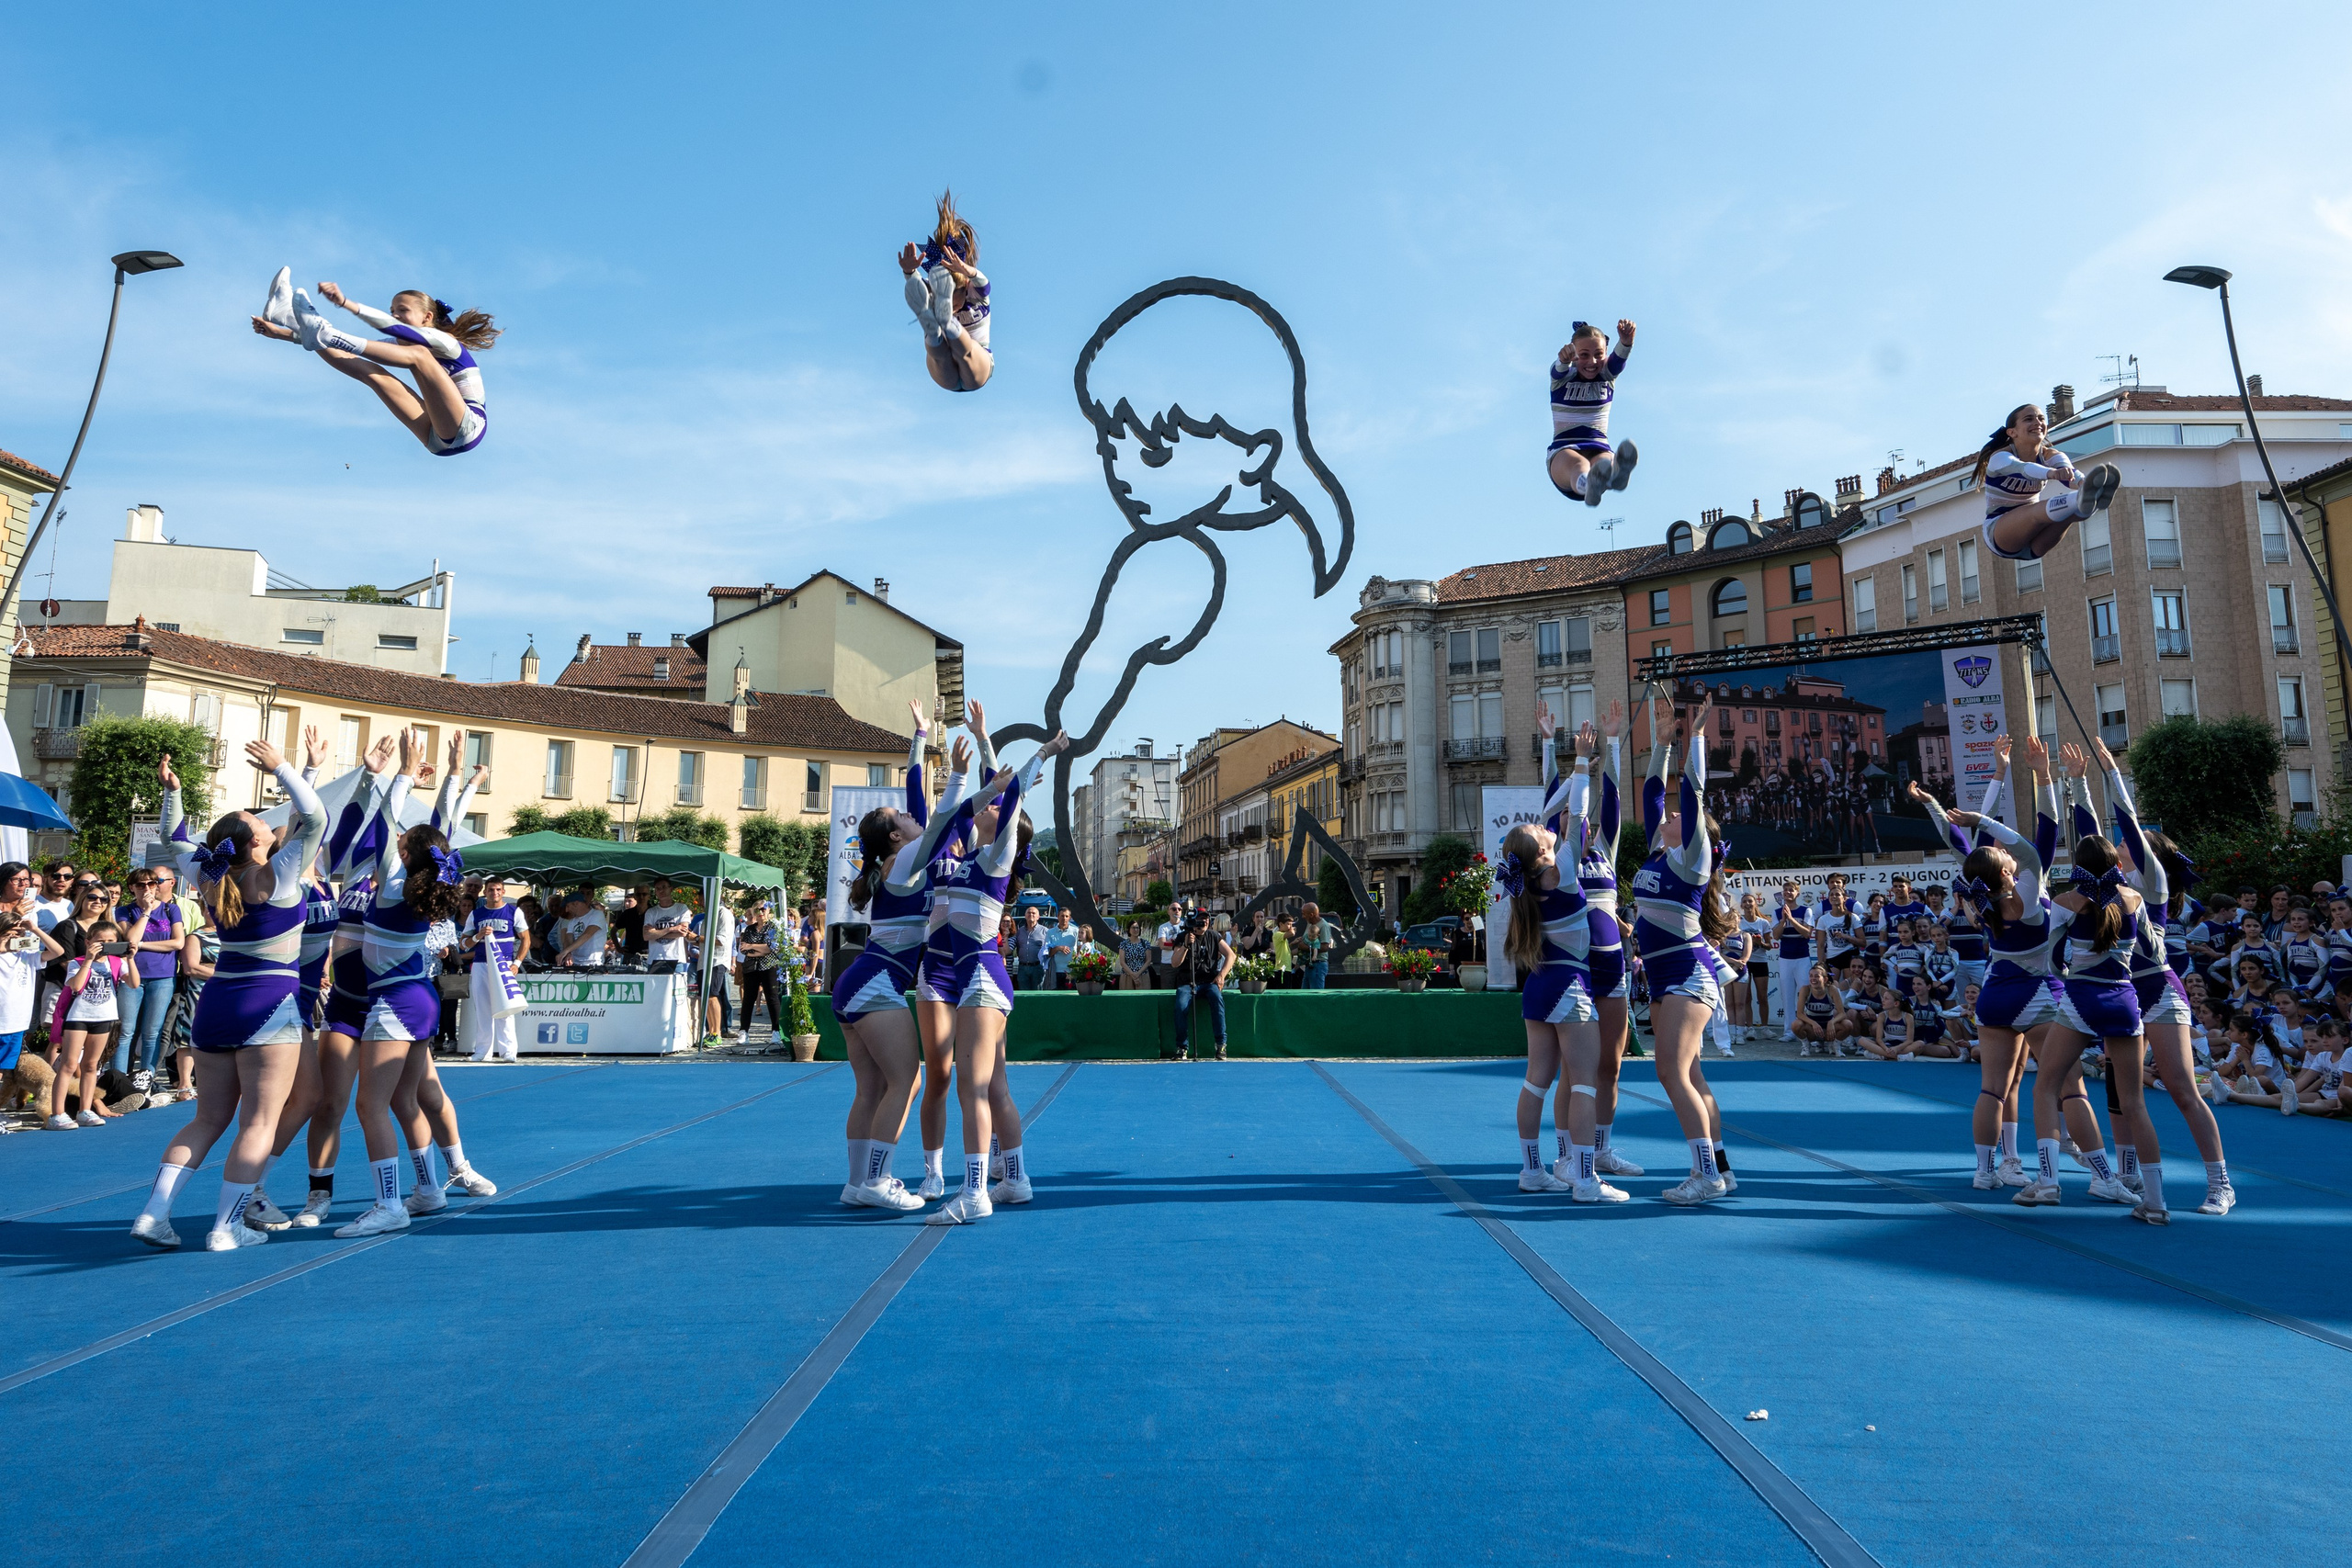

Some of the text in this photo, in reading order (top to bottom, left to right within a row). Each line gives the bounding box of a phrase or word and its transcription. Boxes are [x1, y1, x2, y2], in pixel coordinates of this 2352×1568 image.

[1564, 381, 1608, 400] TITANS
[2049, 496, 2067, 509] TITANS
[1983, 694, 2000, 703] ALBA
[840, 815, 858, 829] 10
[1492, 815, 1510, 829] 10
[839, 851, 857, 860] ALBA
[1724, 877, 1742, 889] HE
[1743, 875, 1791, 887] TITANS
[1879, 872, 1887, 883] 2
[586, 983, 642, 1002] ALBA
[522, 1008, 606, 1018] www.radioalba.it
[870, 1149, 884, 1179] TITANS
[1007, 1155, 1016, 1180] TITANS
[1531, 1144, 1540, 1169] TITANS
[1702, 1144, 1713, 1176] TITANS
[2039, 1146, 2049, 1178] TITANS
[2092, 1155, 2111, 1179] TITANS
[2126, 1150, 2135, 1175] TITANS
[383, 1164, 394, 1200] TITANS
[413, 1155, 428, 1186] TITANS
[971, 1160, 980, 1190] TITANS
